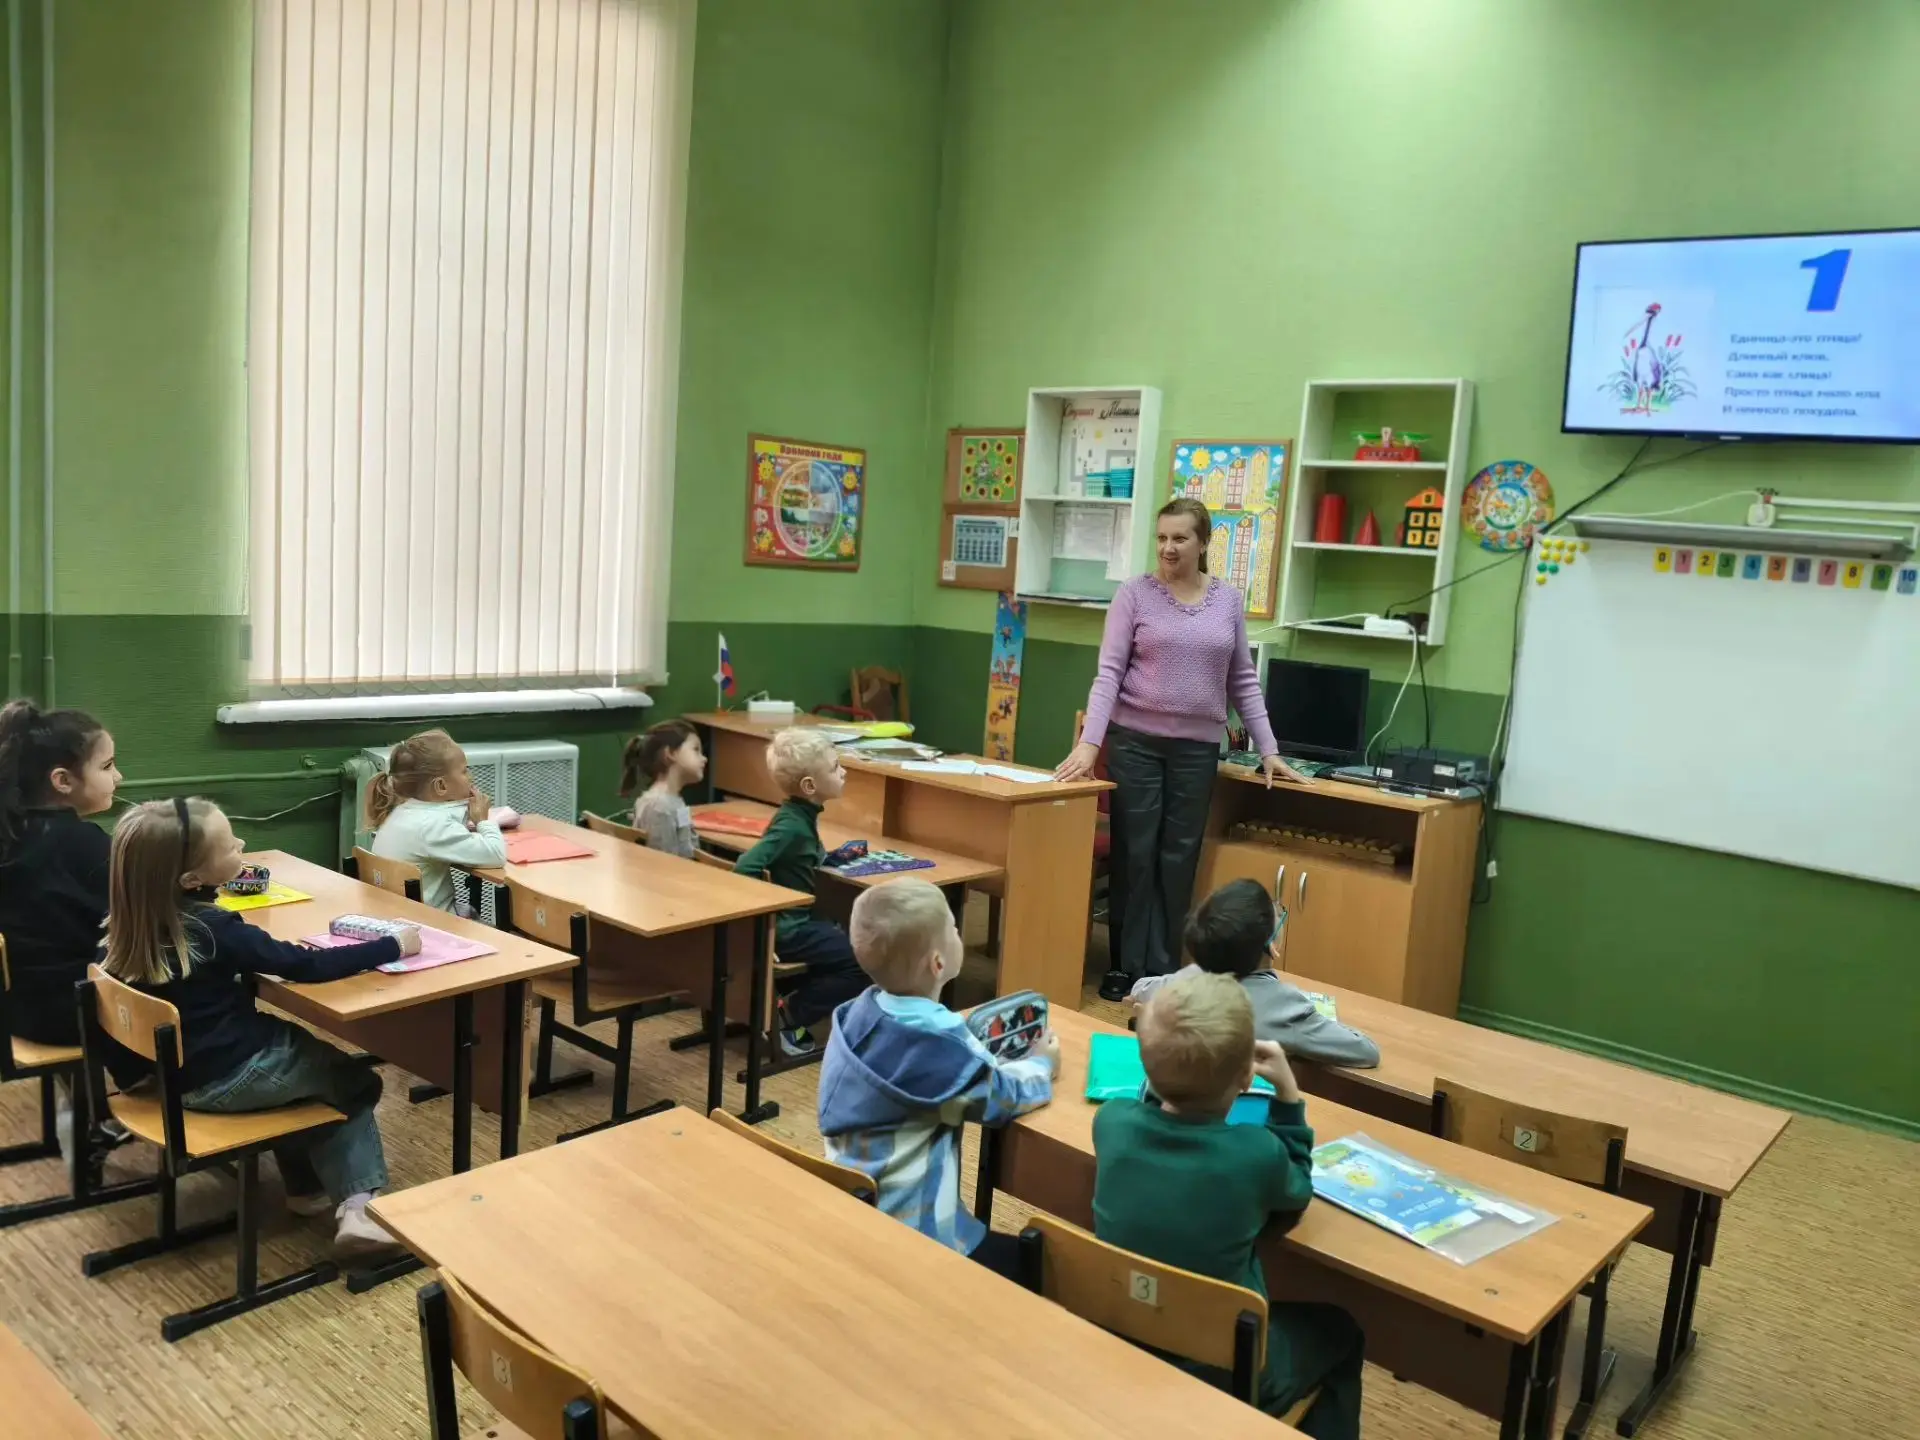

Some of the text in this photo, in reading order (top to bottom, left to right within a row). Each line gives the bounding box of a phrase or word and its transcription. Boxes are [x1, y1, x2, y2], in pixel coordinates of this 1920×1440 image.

[1800, 248, 1852, 312] 1
[1658, 552, 1667, 563] 0
[1701, 555, 1710, 567] 2
[1824, 564, 1832, 576] 7
[1848, 566, 1857, 578] 8
[1902, 569, 1917, 582] 10
[1519, 1130, 1532, 1149] 2
[1136, 1275, 1150, 1300] 3
